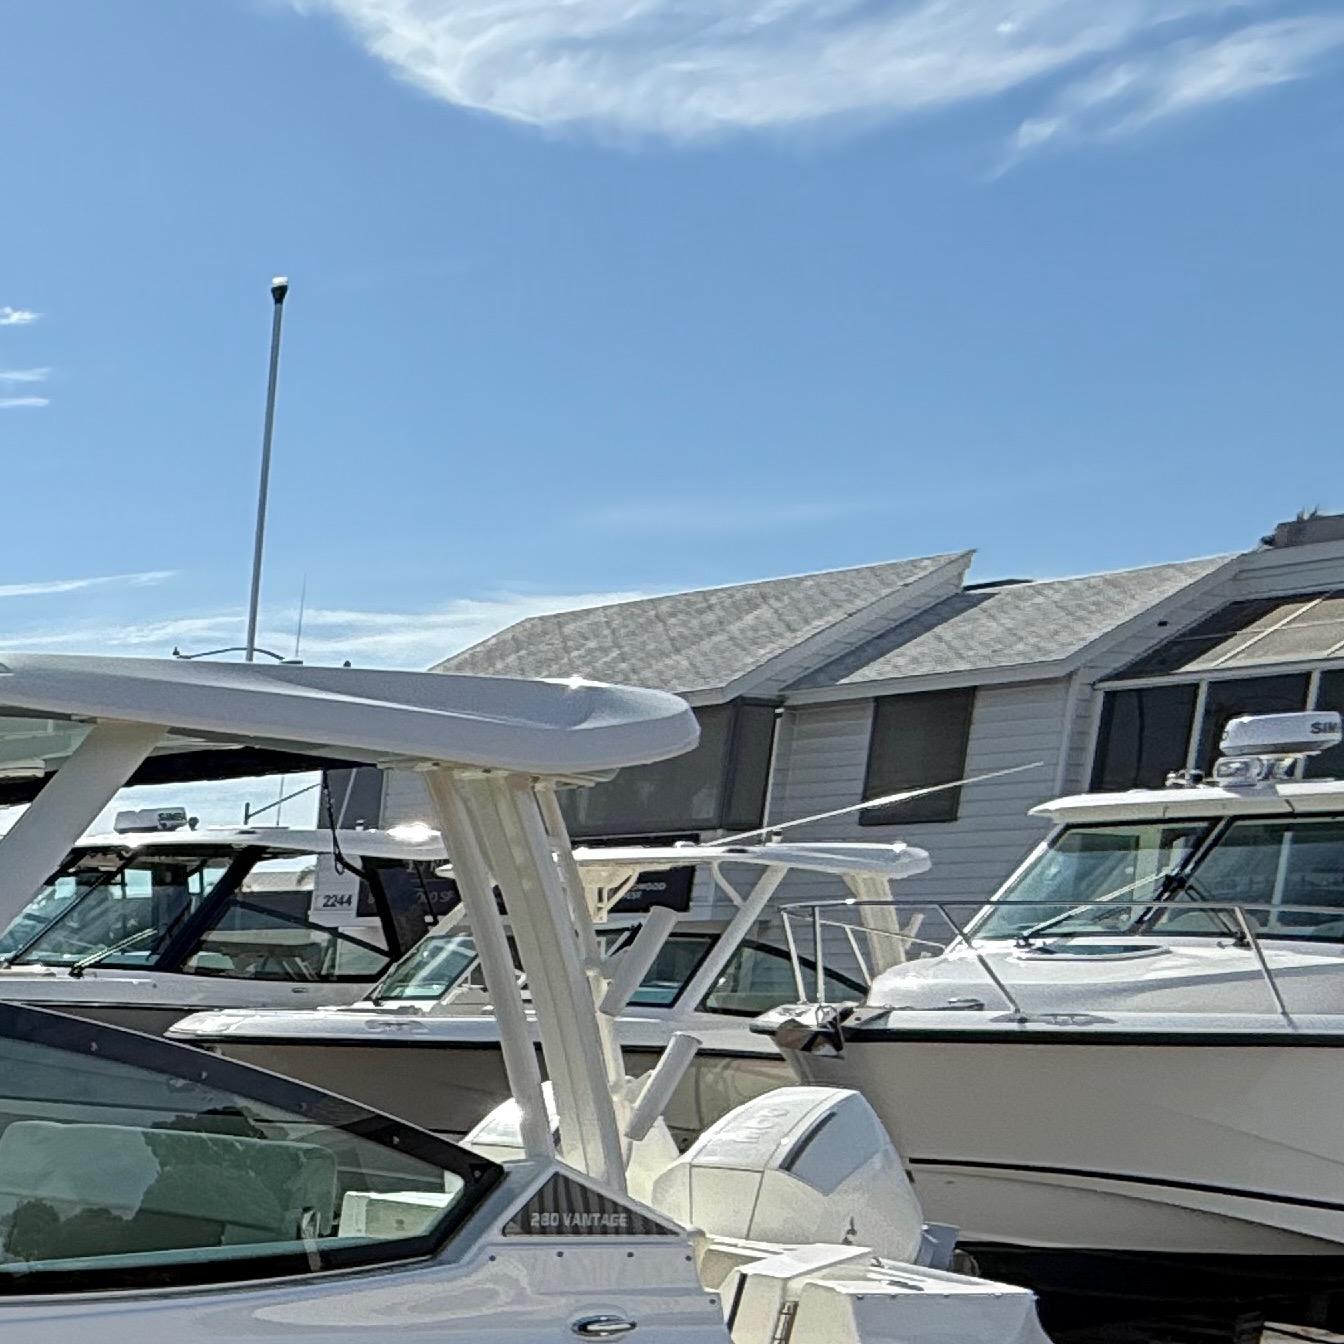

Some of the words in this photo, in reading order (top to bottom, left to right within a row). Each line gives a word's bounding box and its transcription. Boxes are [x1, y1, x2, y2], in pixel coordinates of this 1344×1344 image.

[322, 894, 352, 908] 2244
[530, 1212, 560, 1227] 280
[563, 1212, 629, 1227] VANTAGE
